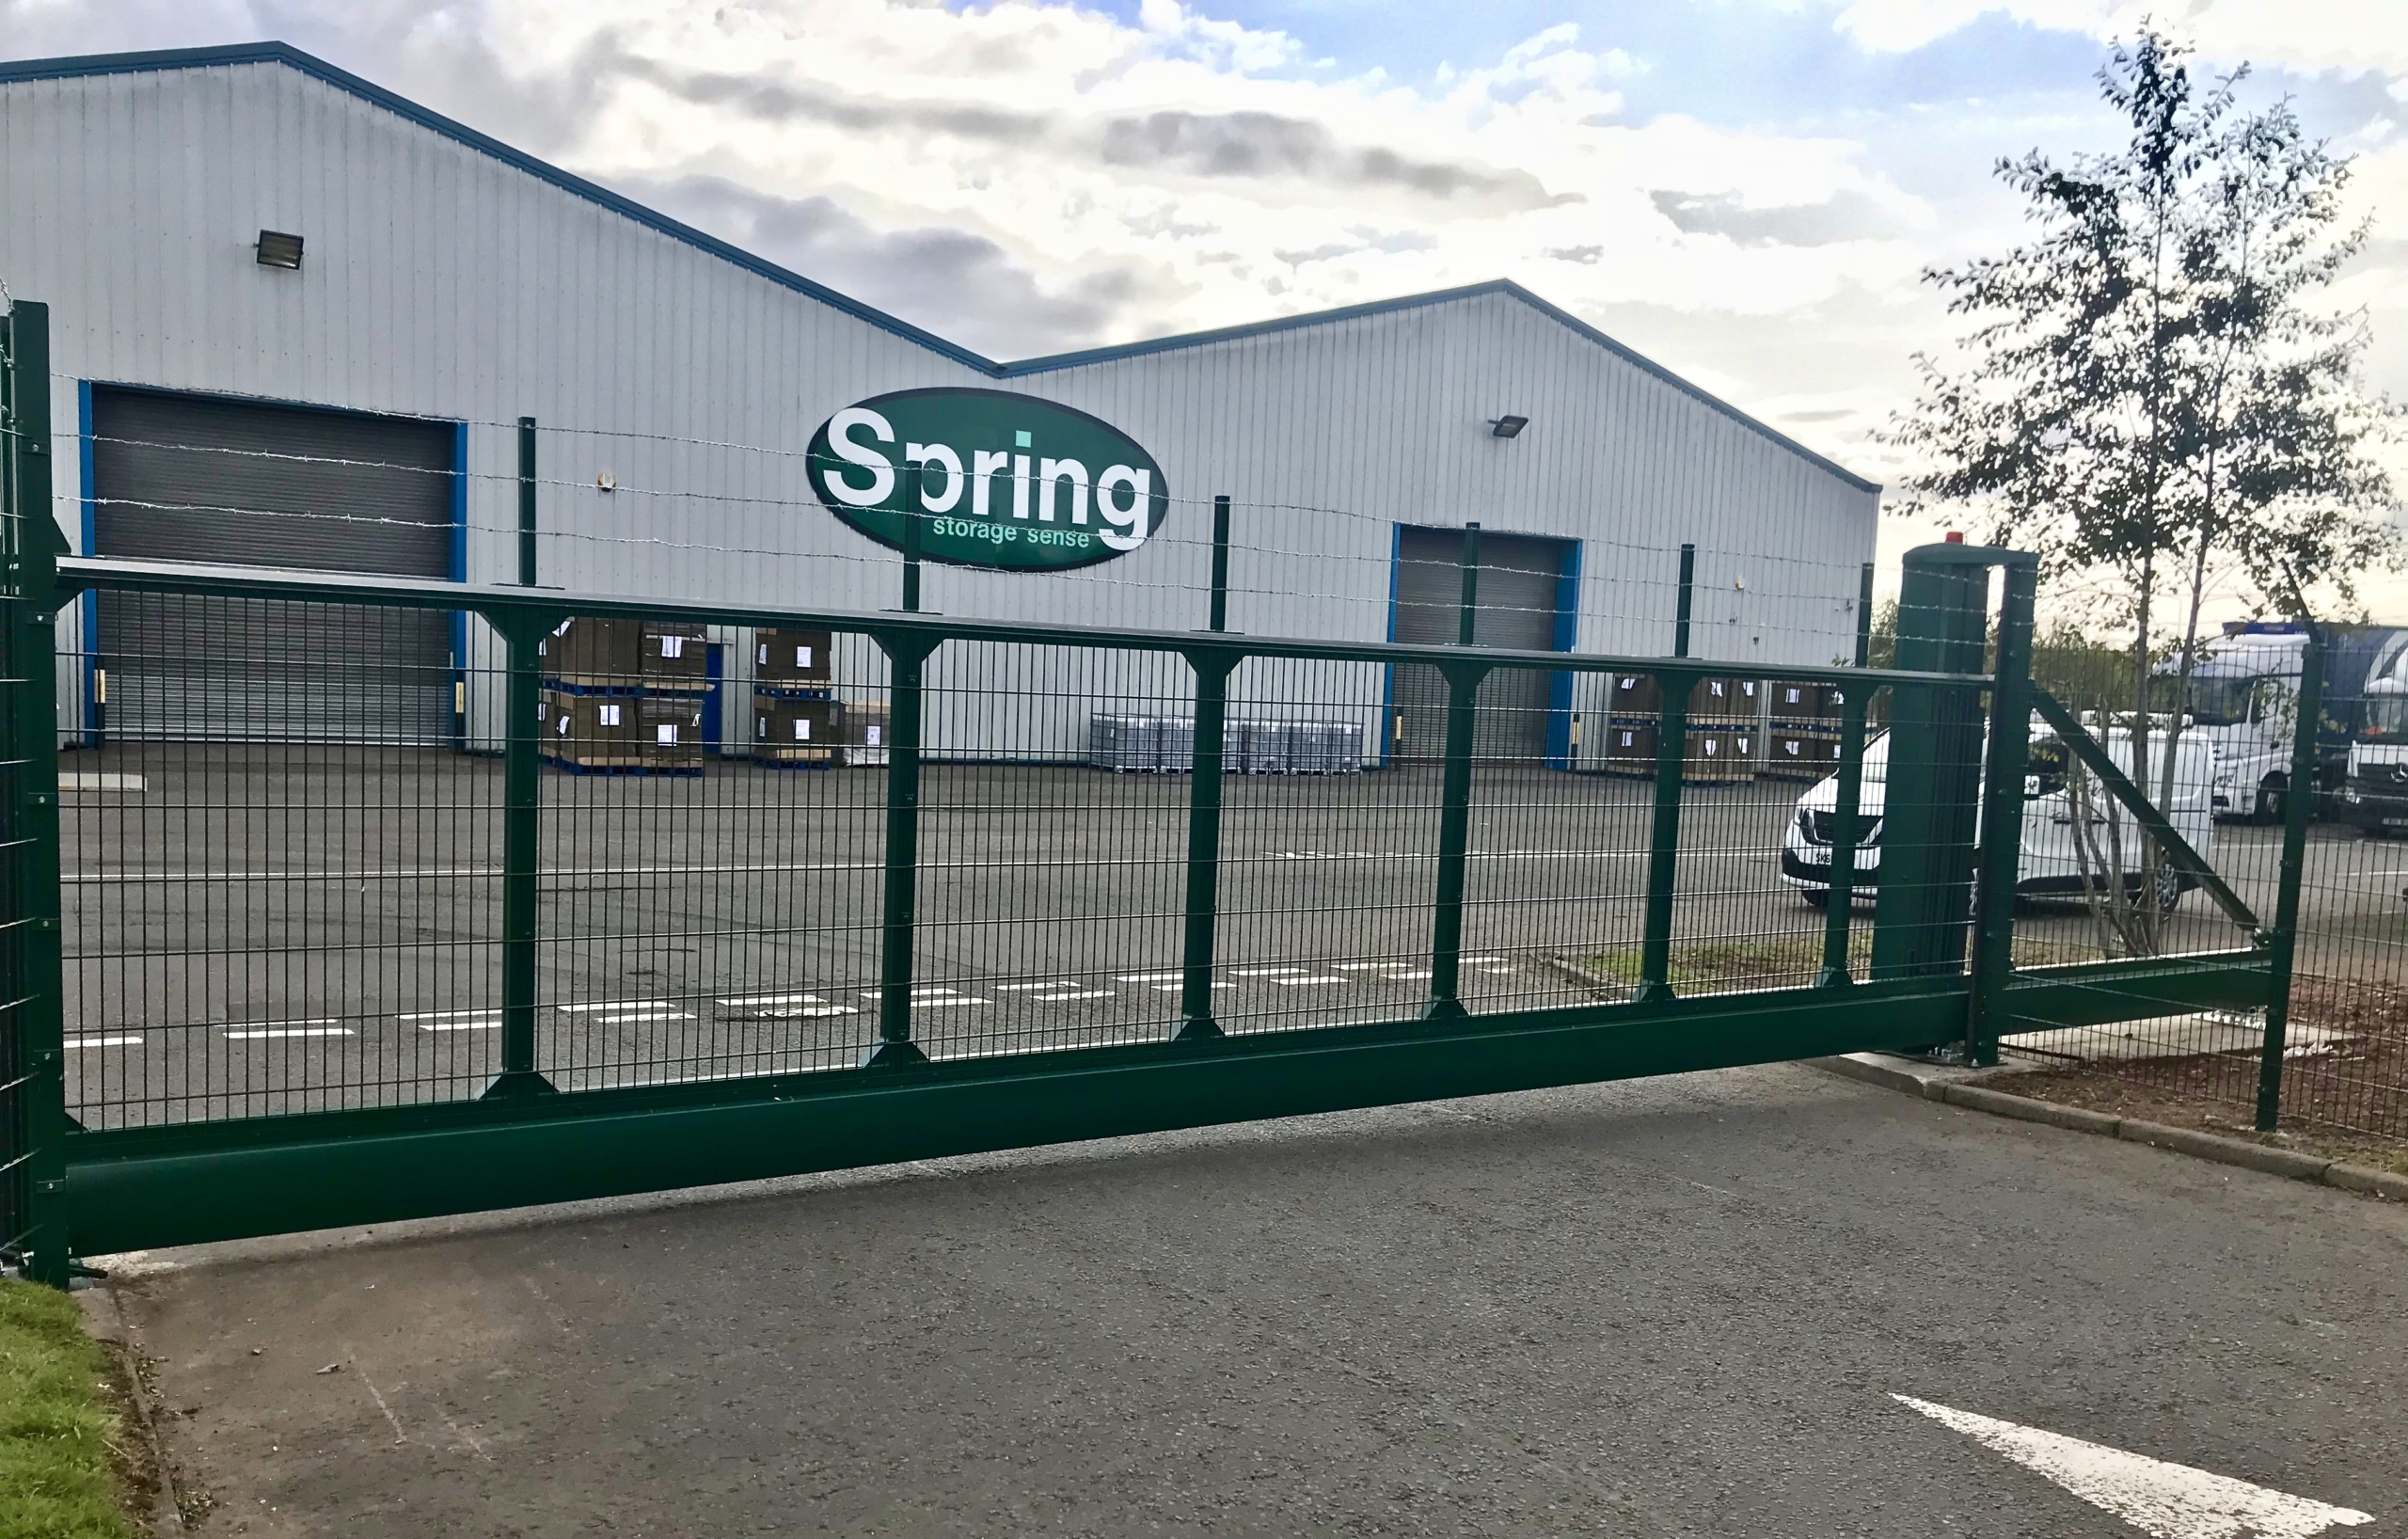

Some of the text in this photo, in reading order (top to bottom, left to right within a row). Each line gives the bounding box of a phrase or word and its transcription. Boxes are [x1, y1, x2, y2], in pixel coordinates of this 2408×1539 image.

[823, 407, 1150, 550] Spring
[933, 518, 1089, 547] storage sense
[1815, 852, 1831, 864] SK6
